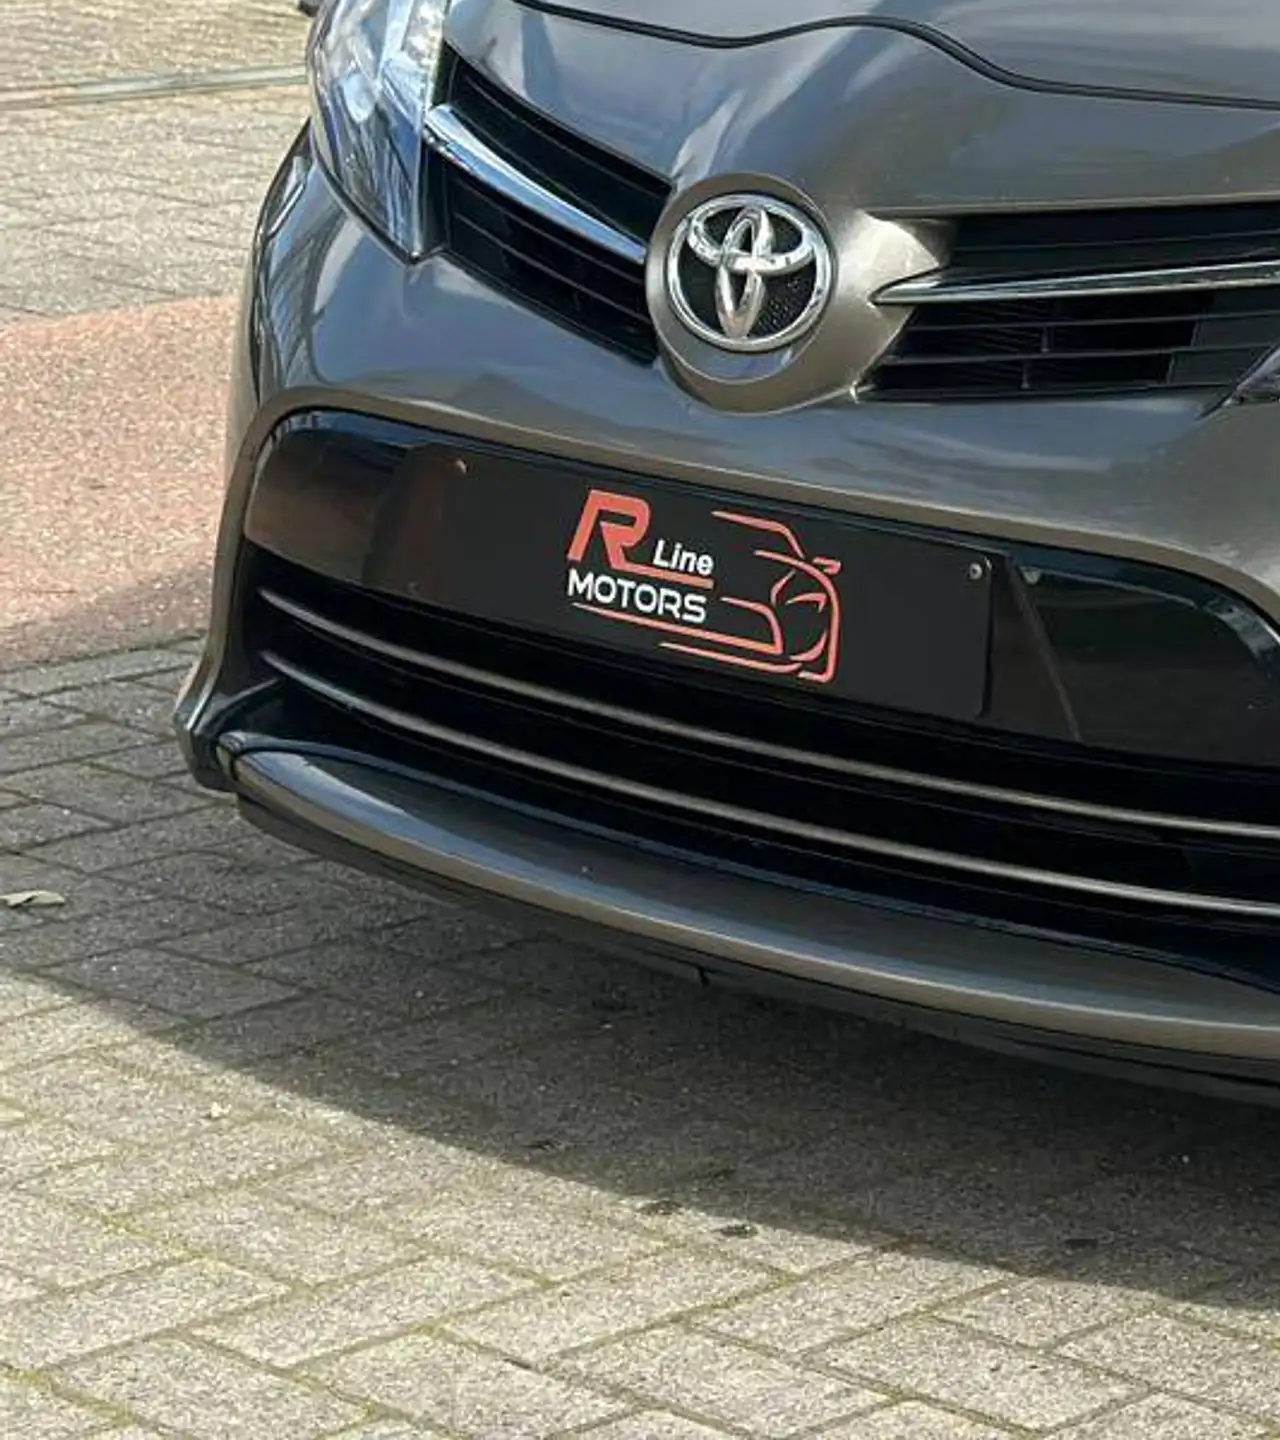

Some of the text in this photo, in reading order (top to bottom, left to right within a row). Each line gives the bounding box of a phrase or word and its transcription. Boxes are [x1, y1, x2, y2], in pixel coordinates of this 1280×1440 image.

[566, 489, 714, 577] R Line
[567, 567, 708, 625] MOTORS
